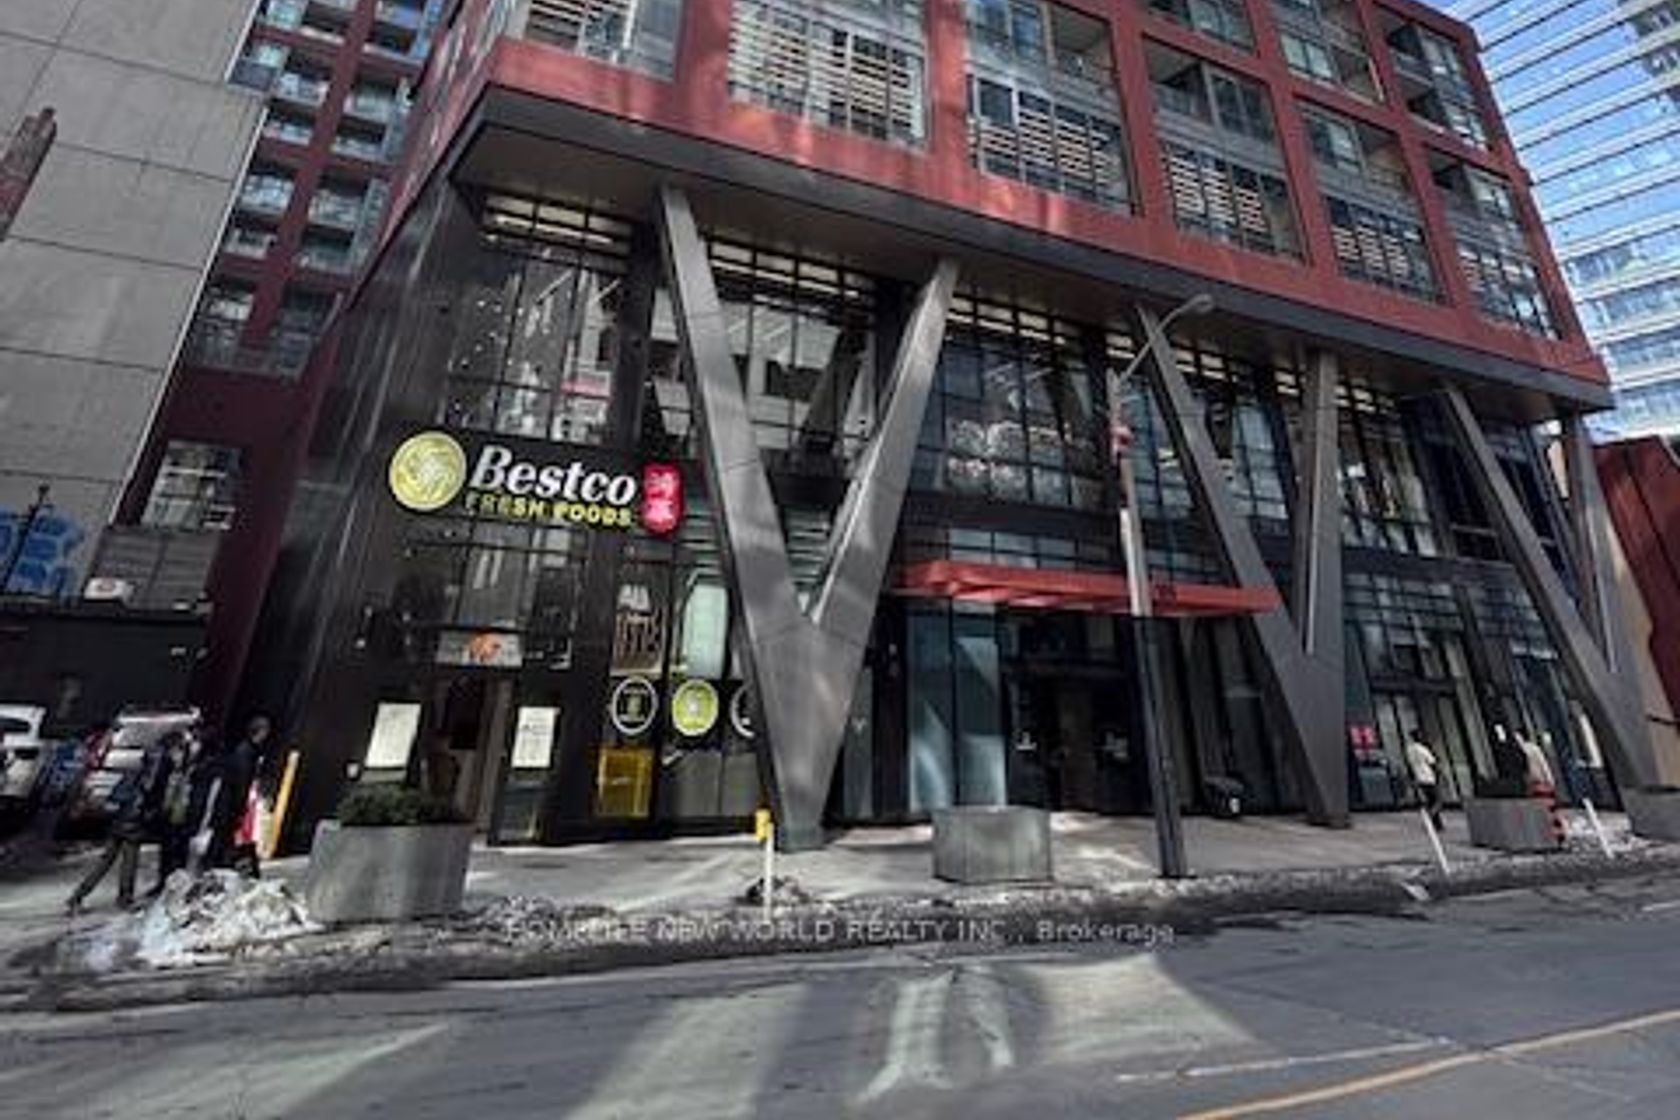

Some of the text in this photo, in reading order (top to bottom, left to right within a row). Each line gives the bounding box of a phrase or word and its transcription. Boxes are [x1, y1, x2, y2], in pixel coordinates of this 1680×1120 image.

[469, 444, 637, 506] Bestco
[465, 490, 545, 518] FRESH
[553, 499, 633, 527] FOODS
